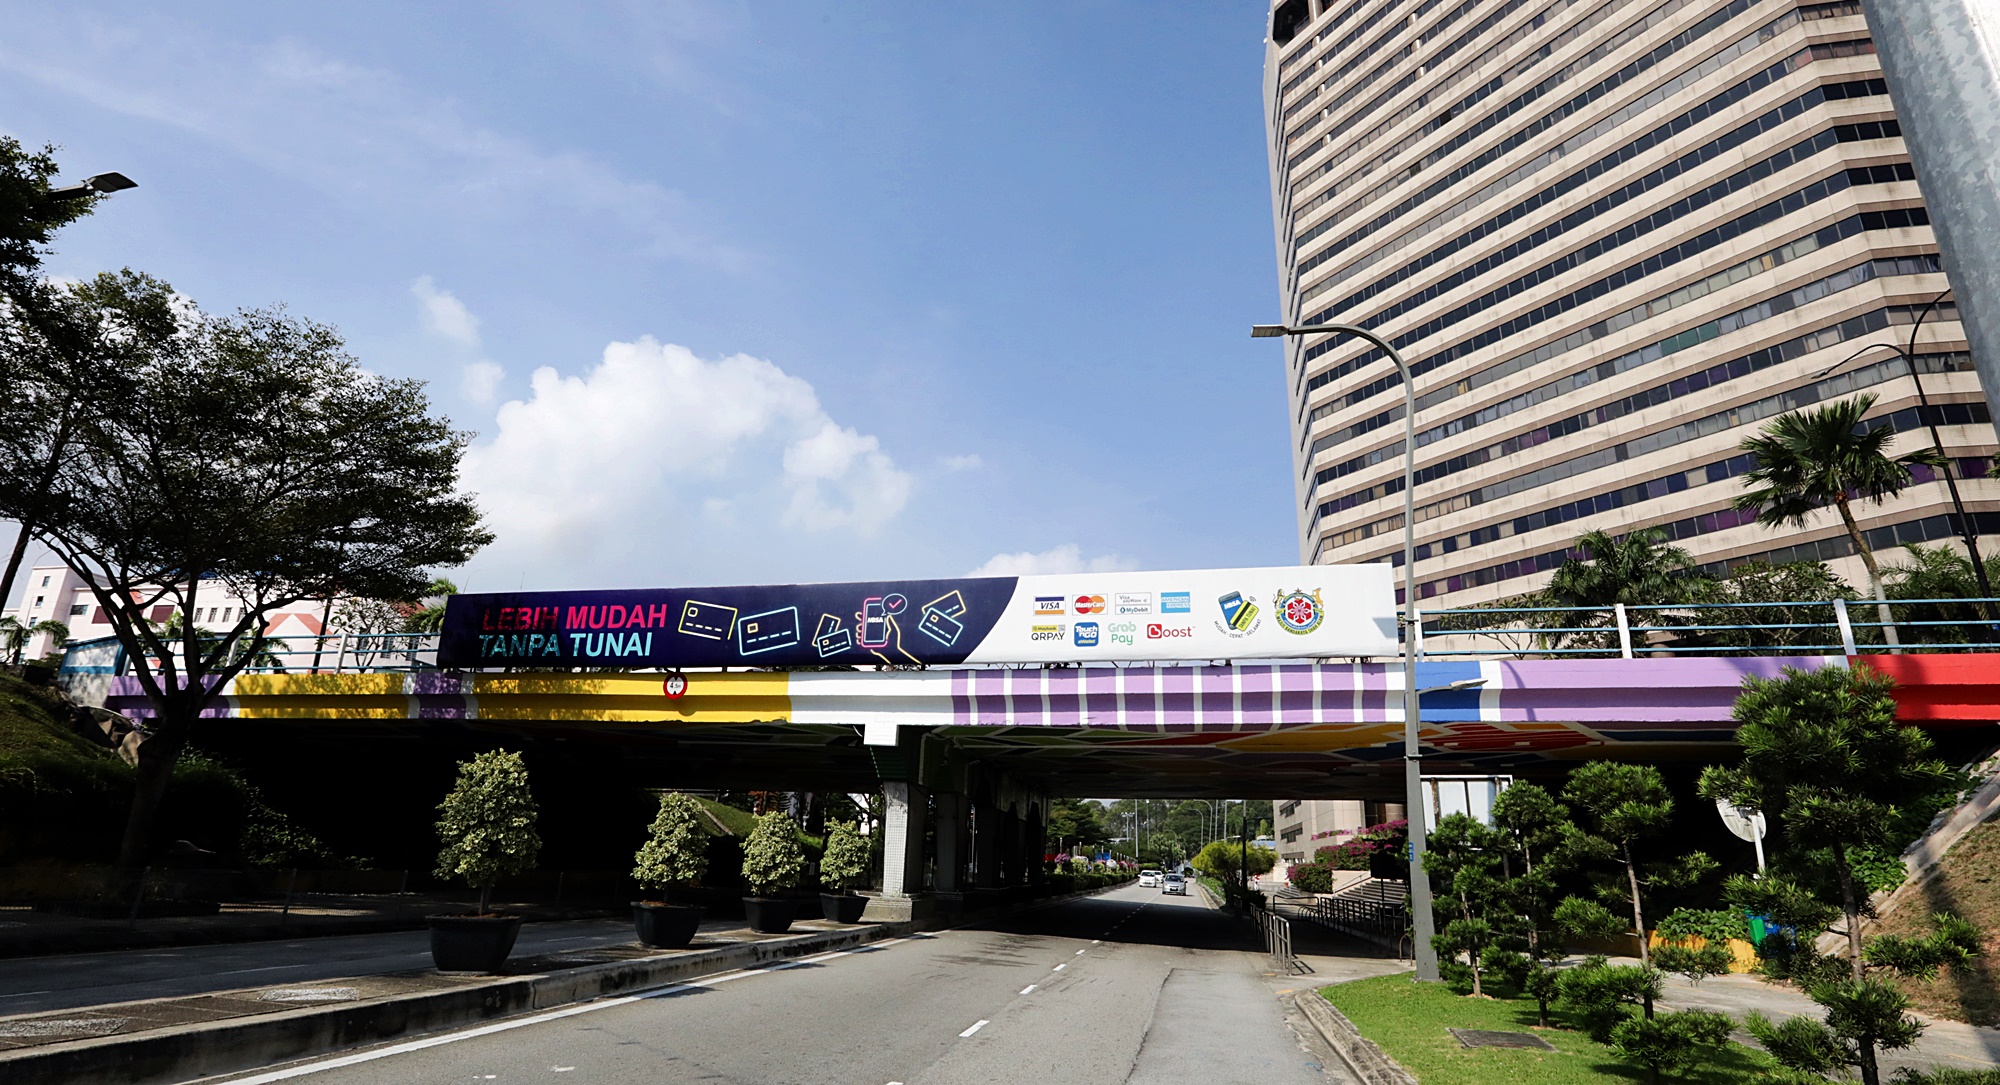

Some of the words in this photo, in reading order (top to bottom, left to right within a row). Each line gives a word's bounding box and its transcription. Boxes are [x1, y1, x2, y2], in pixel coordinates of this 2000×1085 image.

[482, 606, 559, 631] LEBIH
[565, 603, 668, 630] MUDAH
[1075, 625, 1098, 633] Touch
[1108, 621, 1137, 633] Grab
[1031, 632, 1065, 641] QRPAY
[1111, 633, 1134, 646] Pay
[478, 632, 561, 658] TANPA
[569, 631, 653, 658] TUNAI
